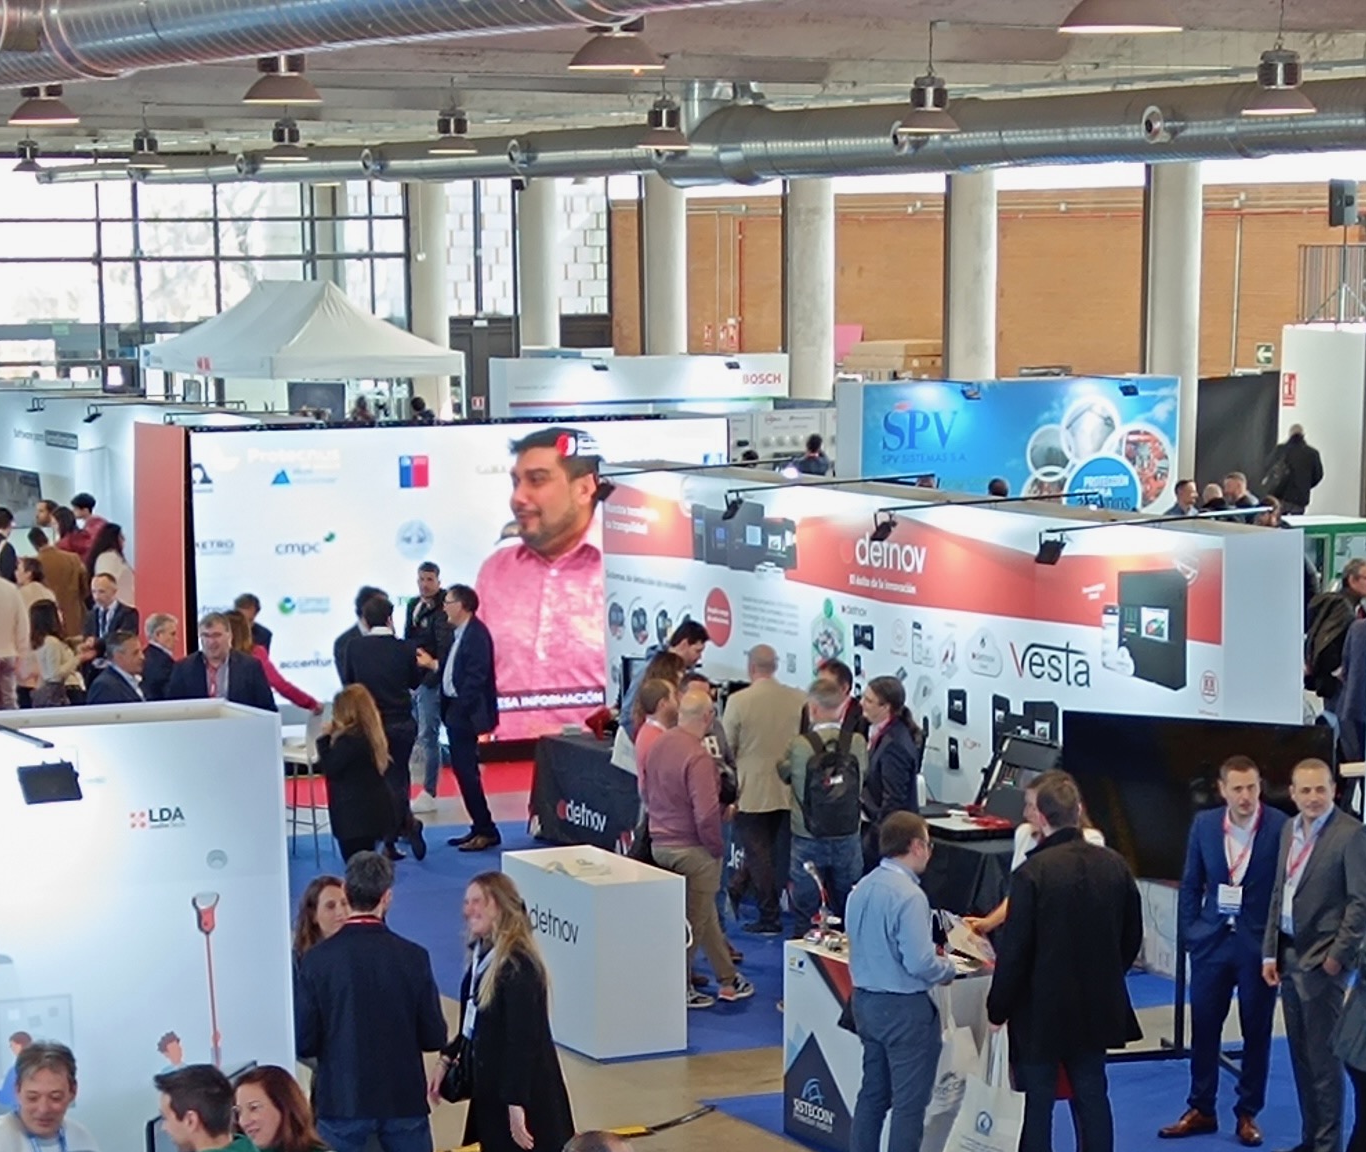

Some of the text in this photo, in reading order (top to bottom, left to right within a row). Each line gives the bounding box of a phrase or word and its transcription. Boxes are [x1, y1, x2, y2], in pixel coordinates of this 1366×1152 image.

[743, 373, 781, 384] BOSCH
[882, 408, 958, 451] SPV
[881, 455, 900, 465] SPV
[903, 454, 947, 464] SISTEMAS
[275, 543, 321, 555] cmpc
[855, 536, 927, 574] detnov
[280, 657, 332, 669] accentur
[1009, 641, 1091, 688] Vesta
[521, 691, 604, 707] INFORMACIÓN
[148, 807, 186, 824] LDA
[565, 800, 607, 833] detnov
[531, 904, 579, 945] detnov
[793, 1098, 834, 1125] SISTECOIN
